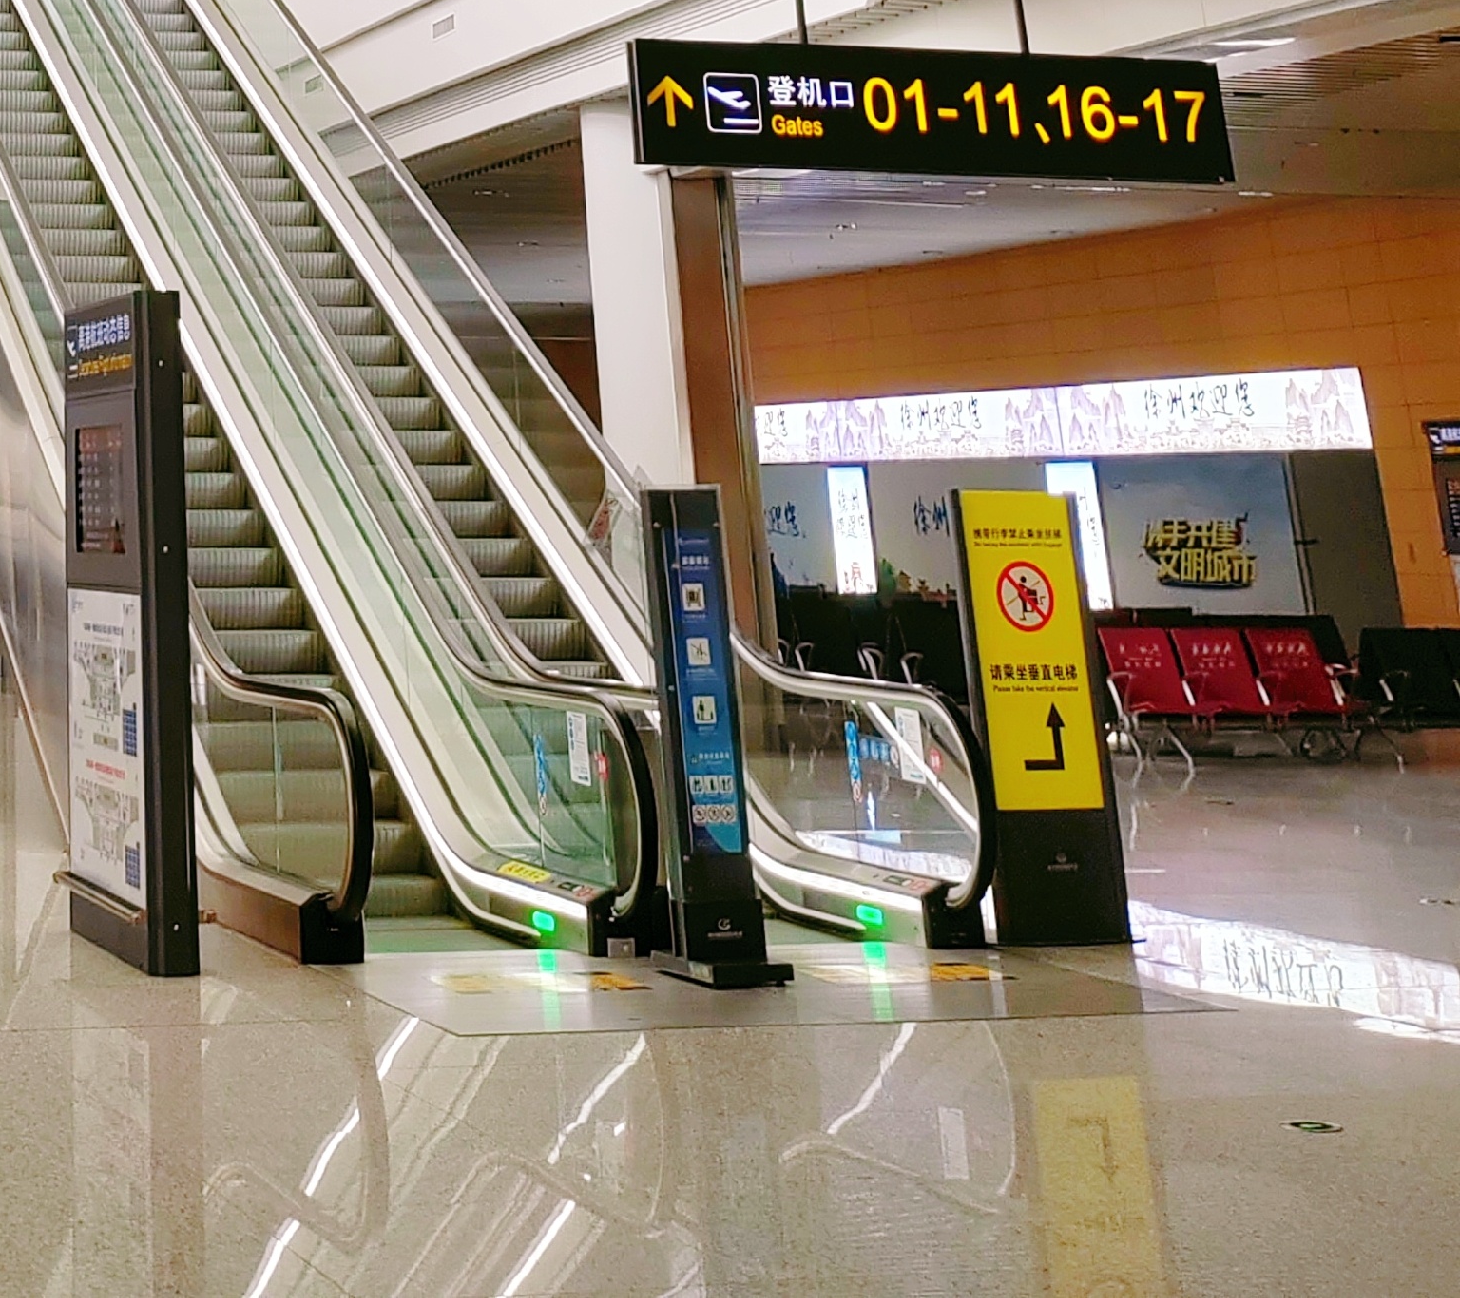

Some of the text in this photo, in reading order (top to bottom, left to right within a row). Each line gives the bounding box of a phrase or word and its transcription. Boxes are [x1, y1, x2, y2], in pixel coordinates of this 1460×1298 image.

[766, 74, 855, 108] 登机口
[771, 113, 824, 137] Gates
[1157, 546, 1257, 584] 文明城市
[989, 663, 1079, 681] 请乘坐垂直电梯
